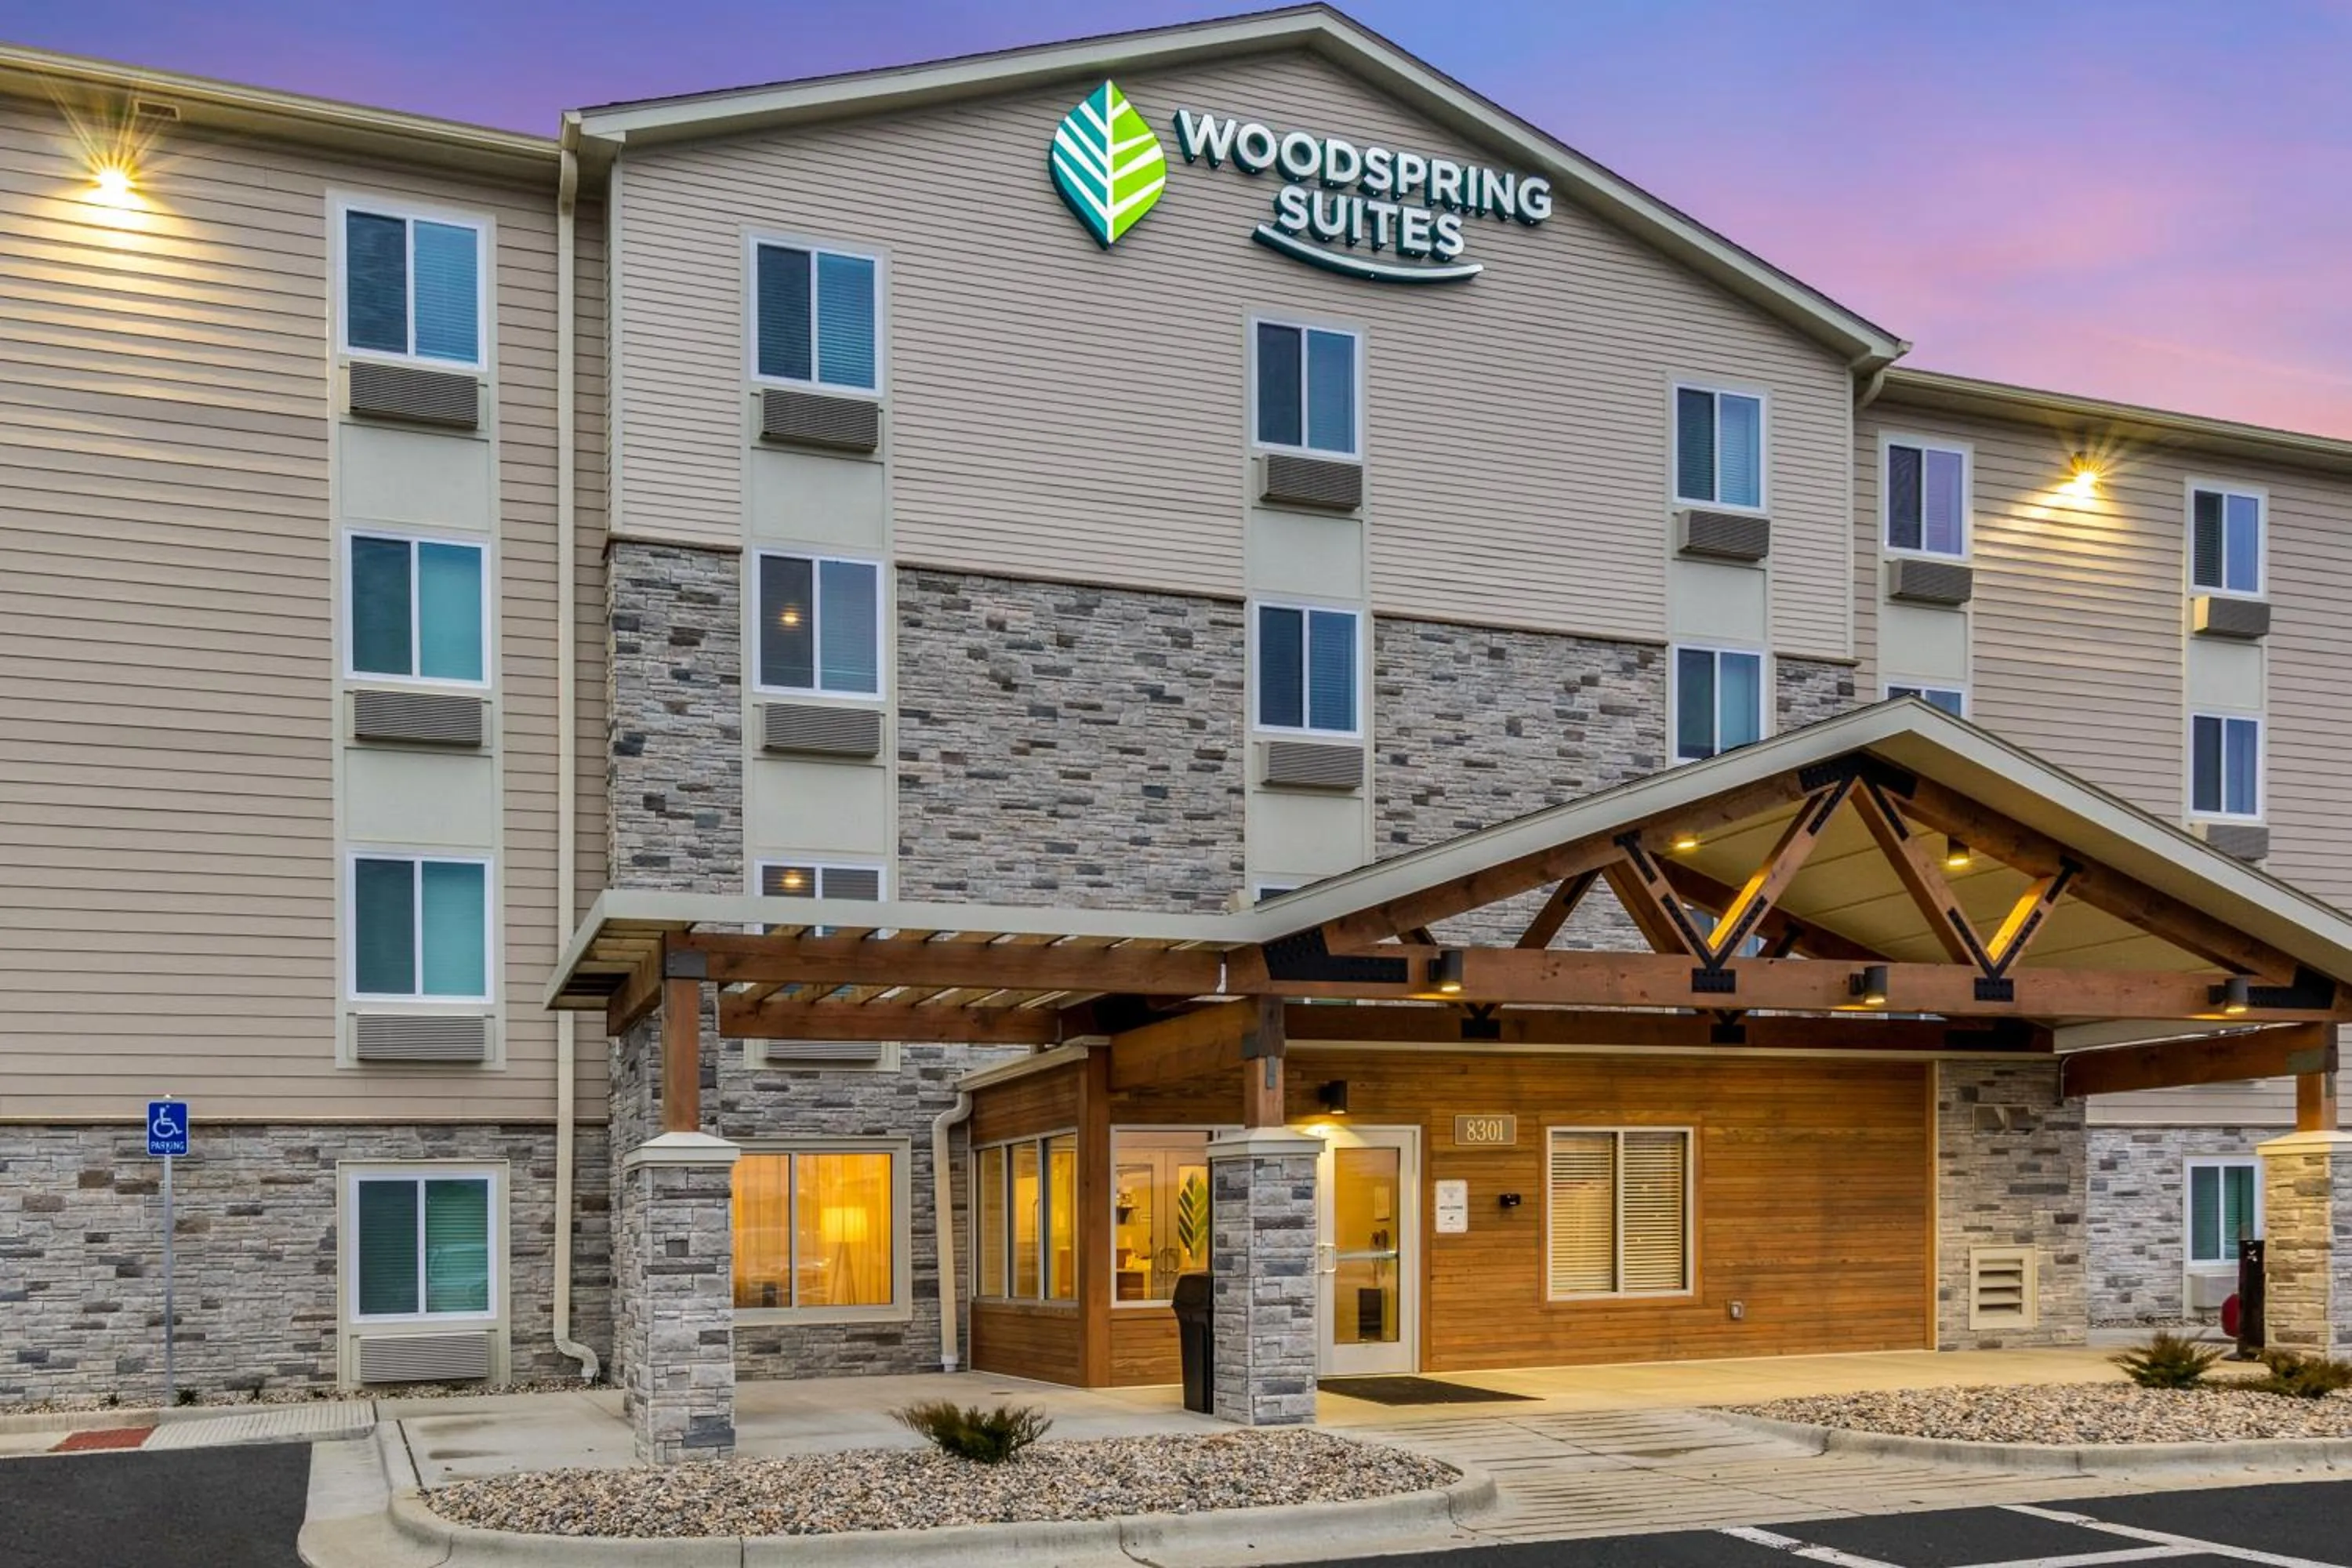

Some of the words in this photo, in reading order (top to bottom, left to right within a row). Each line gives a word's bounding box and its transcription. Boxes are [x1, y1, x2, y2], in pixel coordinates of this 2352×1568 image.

[1174, 108, 1552, 224] WOODSPRING
[1275, 184, 1464, 260] SUITES
[151, 1141, 184, 1150] PARKING
[1467, 1119, 1504, 1142] 8301
